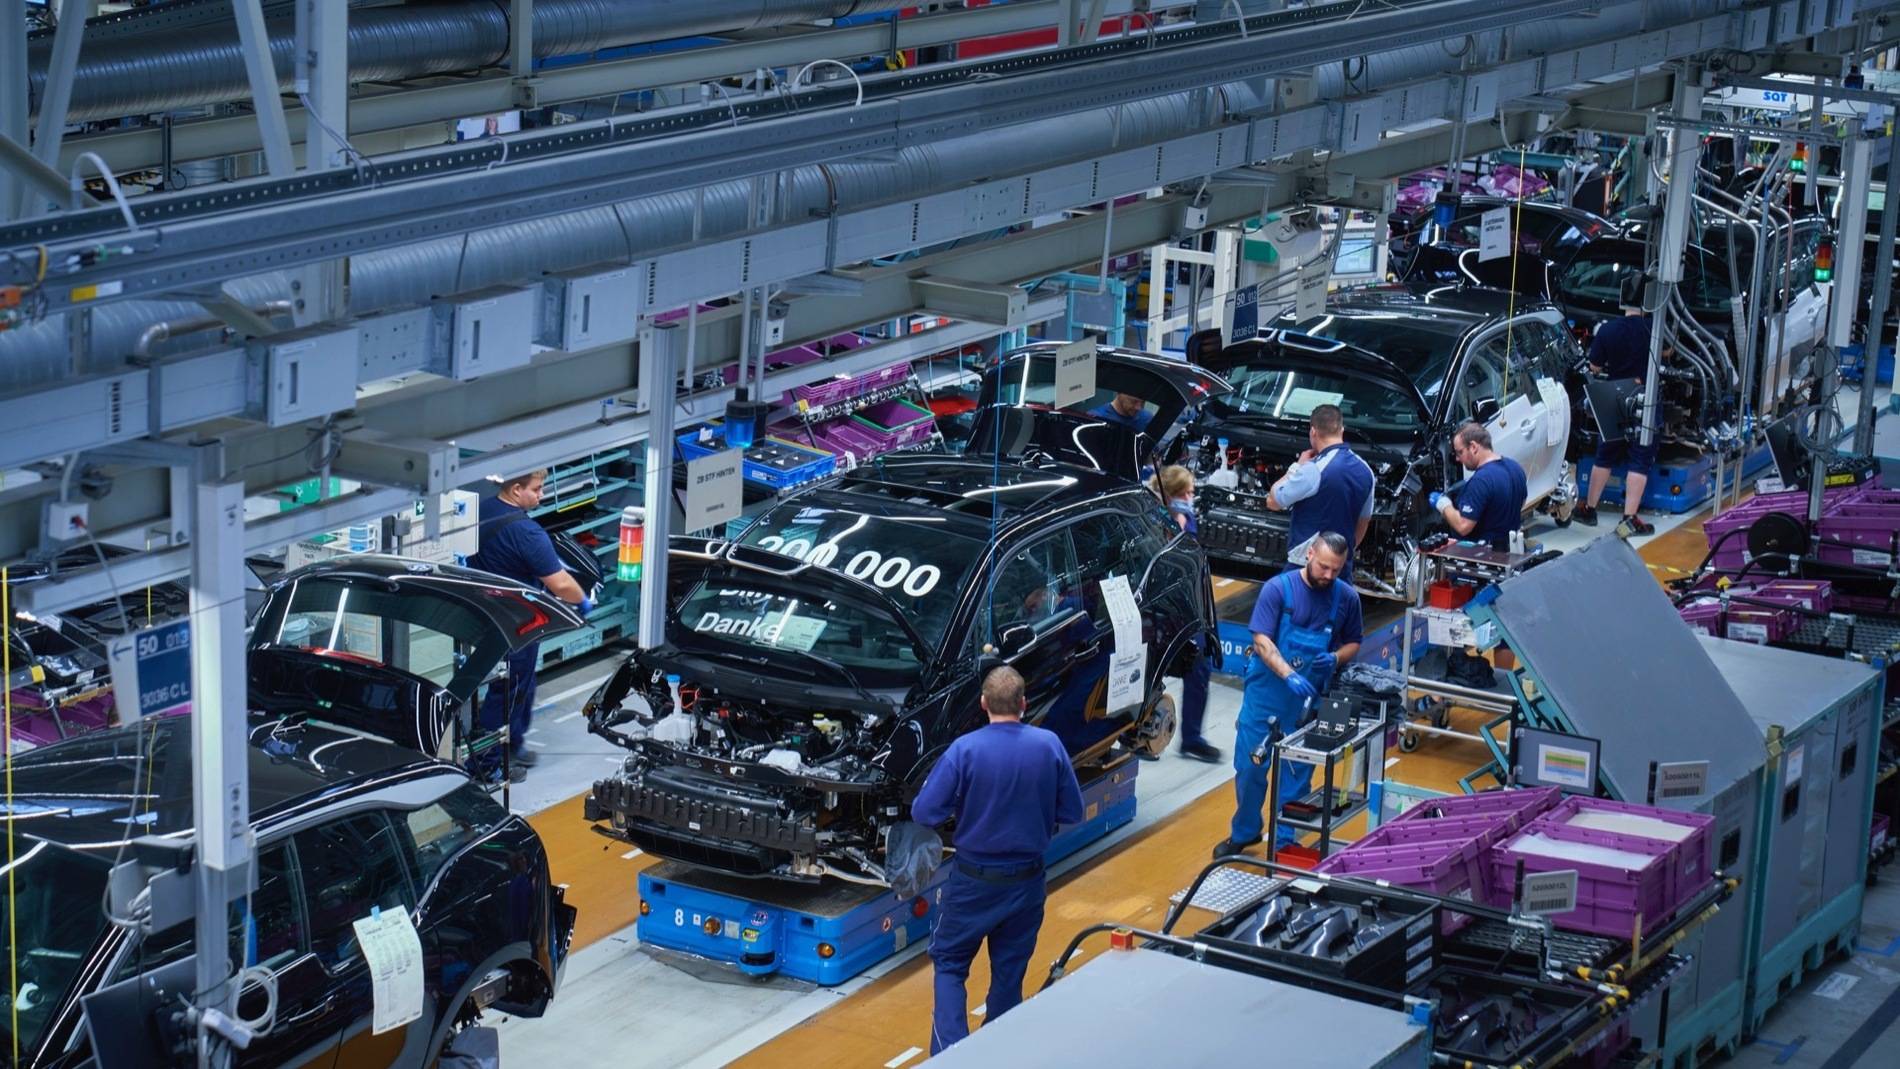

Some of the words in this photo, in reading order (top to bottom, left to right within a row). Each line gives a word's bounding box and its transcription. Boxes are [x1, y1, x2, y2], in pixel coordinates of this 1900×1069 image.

[1236, 292, 1246, 306] 50
[139, 634, 159, 656] 50
[675, 908, 684, 927] 8
